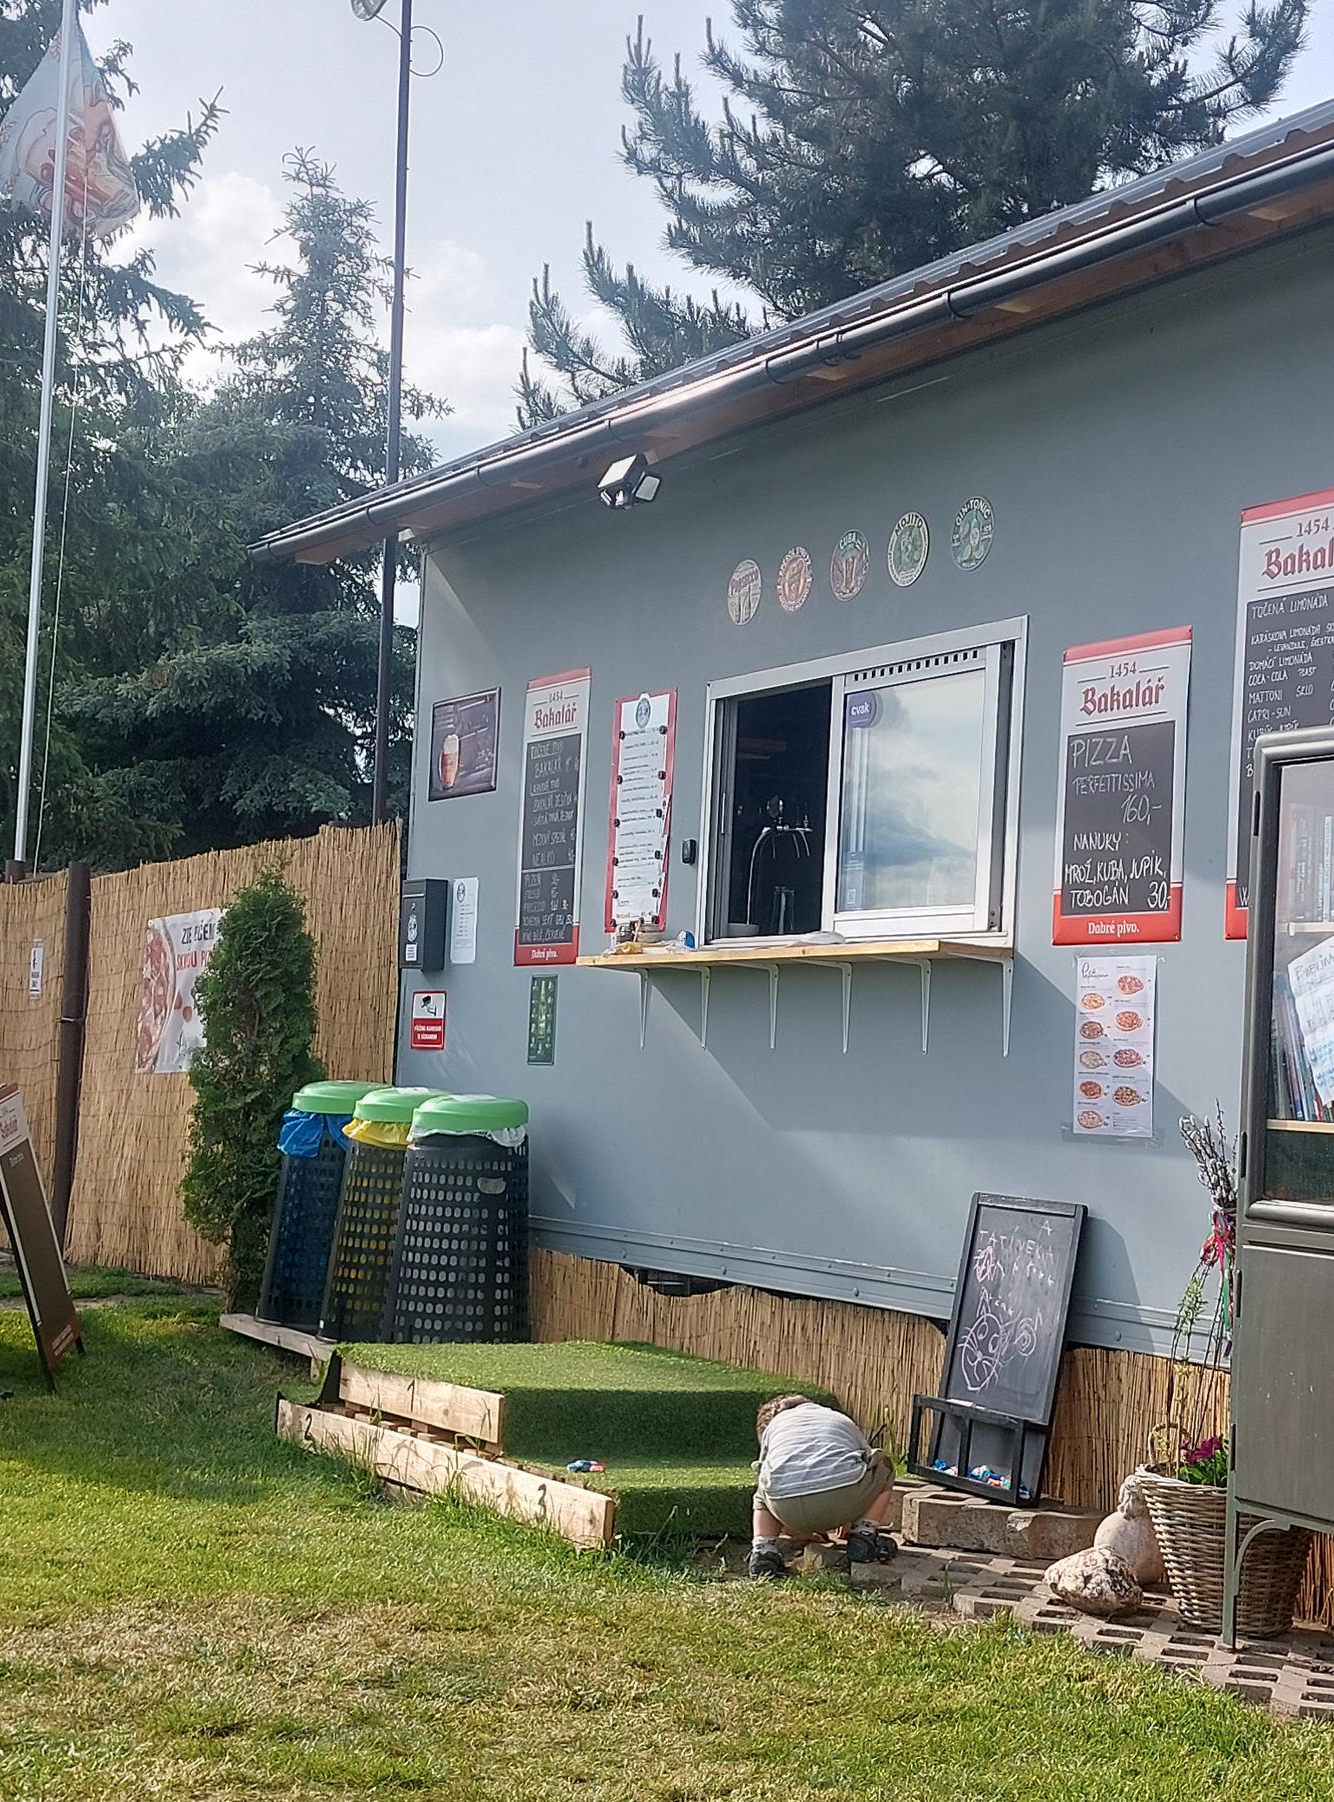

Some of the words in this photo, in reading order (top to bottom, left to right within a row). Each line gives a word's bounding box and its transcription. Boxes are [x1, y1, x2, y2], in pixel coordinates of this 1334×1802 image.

[895, 513, 924, 536] MOJITO
[1297, 516, 1330, 538] 1454
[1251, 597, 1286, 619] TOČENÁ
[1290, 592, 1328, 613] LIMONÁDA
[1109, 661, 1137, 678] 1454
[1279, 651, 1313, 667] LIMONÁDA
[1079, 676, 1165, 716] Bakalář
[1248, 690, 1283, 704] MATTONI
[534, 702, 577, 729] Bakalář
[851, 701, 871, 716] cvak
[1070, 735, 1132, 768] PIZZA
[1073, 771, 1155, 795] PERFETTISSIMA
[1088, 920, 1115, 935] Dobré
[1117, 919, 1140, 938] pivo.
